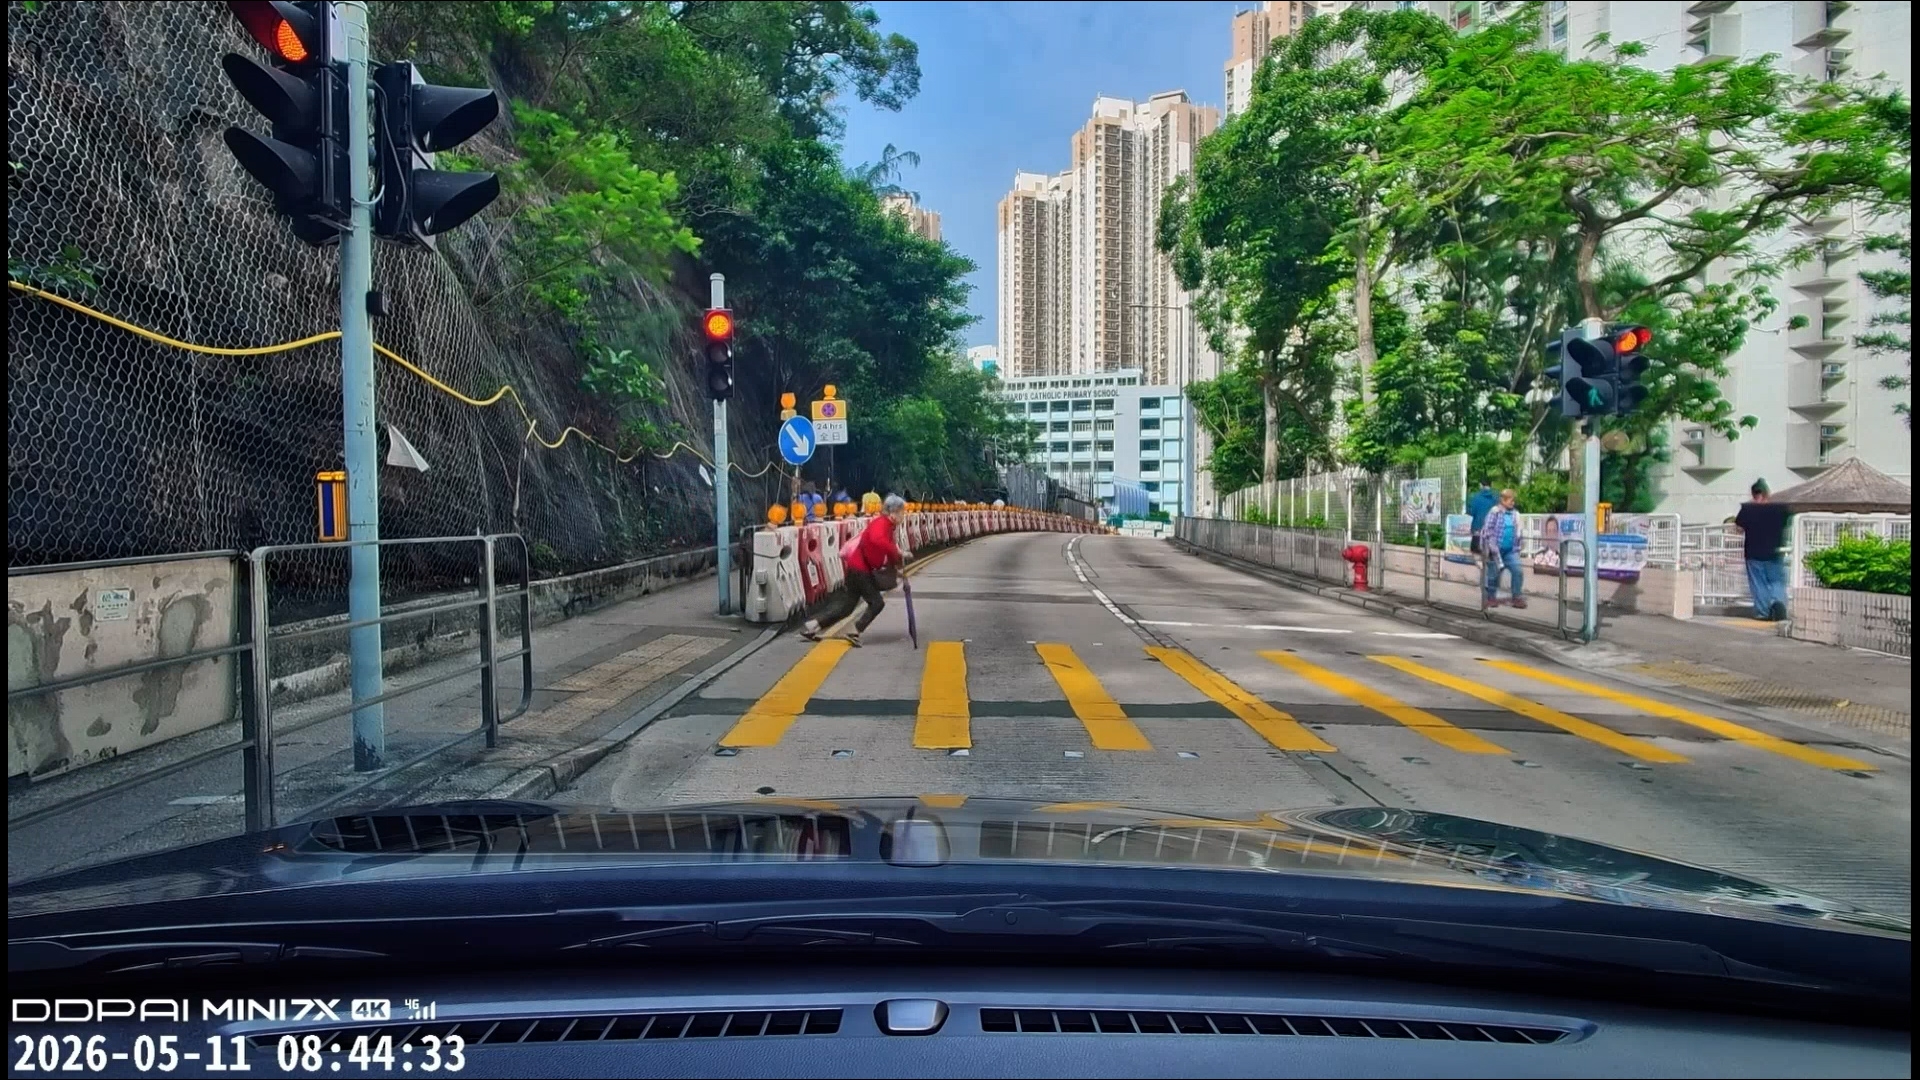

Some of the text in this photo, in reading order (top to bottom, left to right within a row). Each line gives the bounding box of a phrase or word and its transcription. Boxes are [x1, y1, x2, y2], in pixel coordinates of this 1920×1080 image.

[1030, 391, 1062, 400] CATHOLIC
[1063, 390, 1092, 399] PRIMARY
[1093, 389, 1119, 398] SCHOOL
[820, 432, 840, 441] 全日
